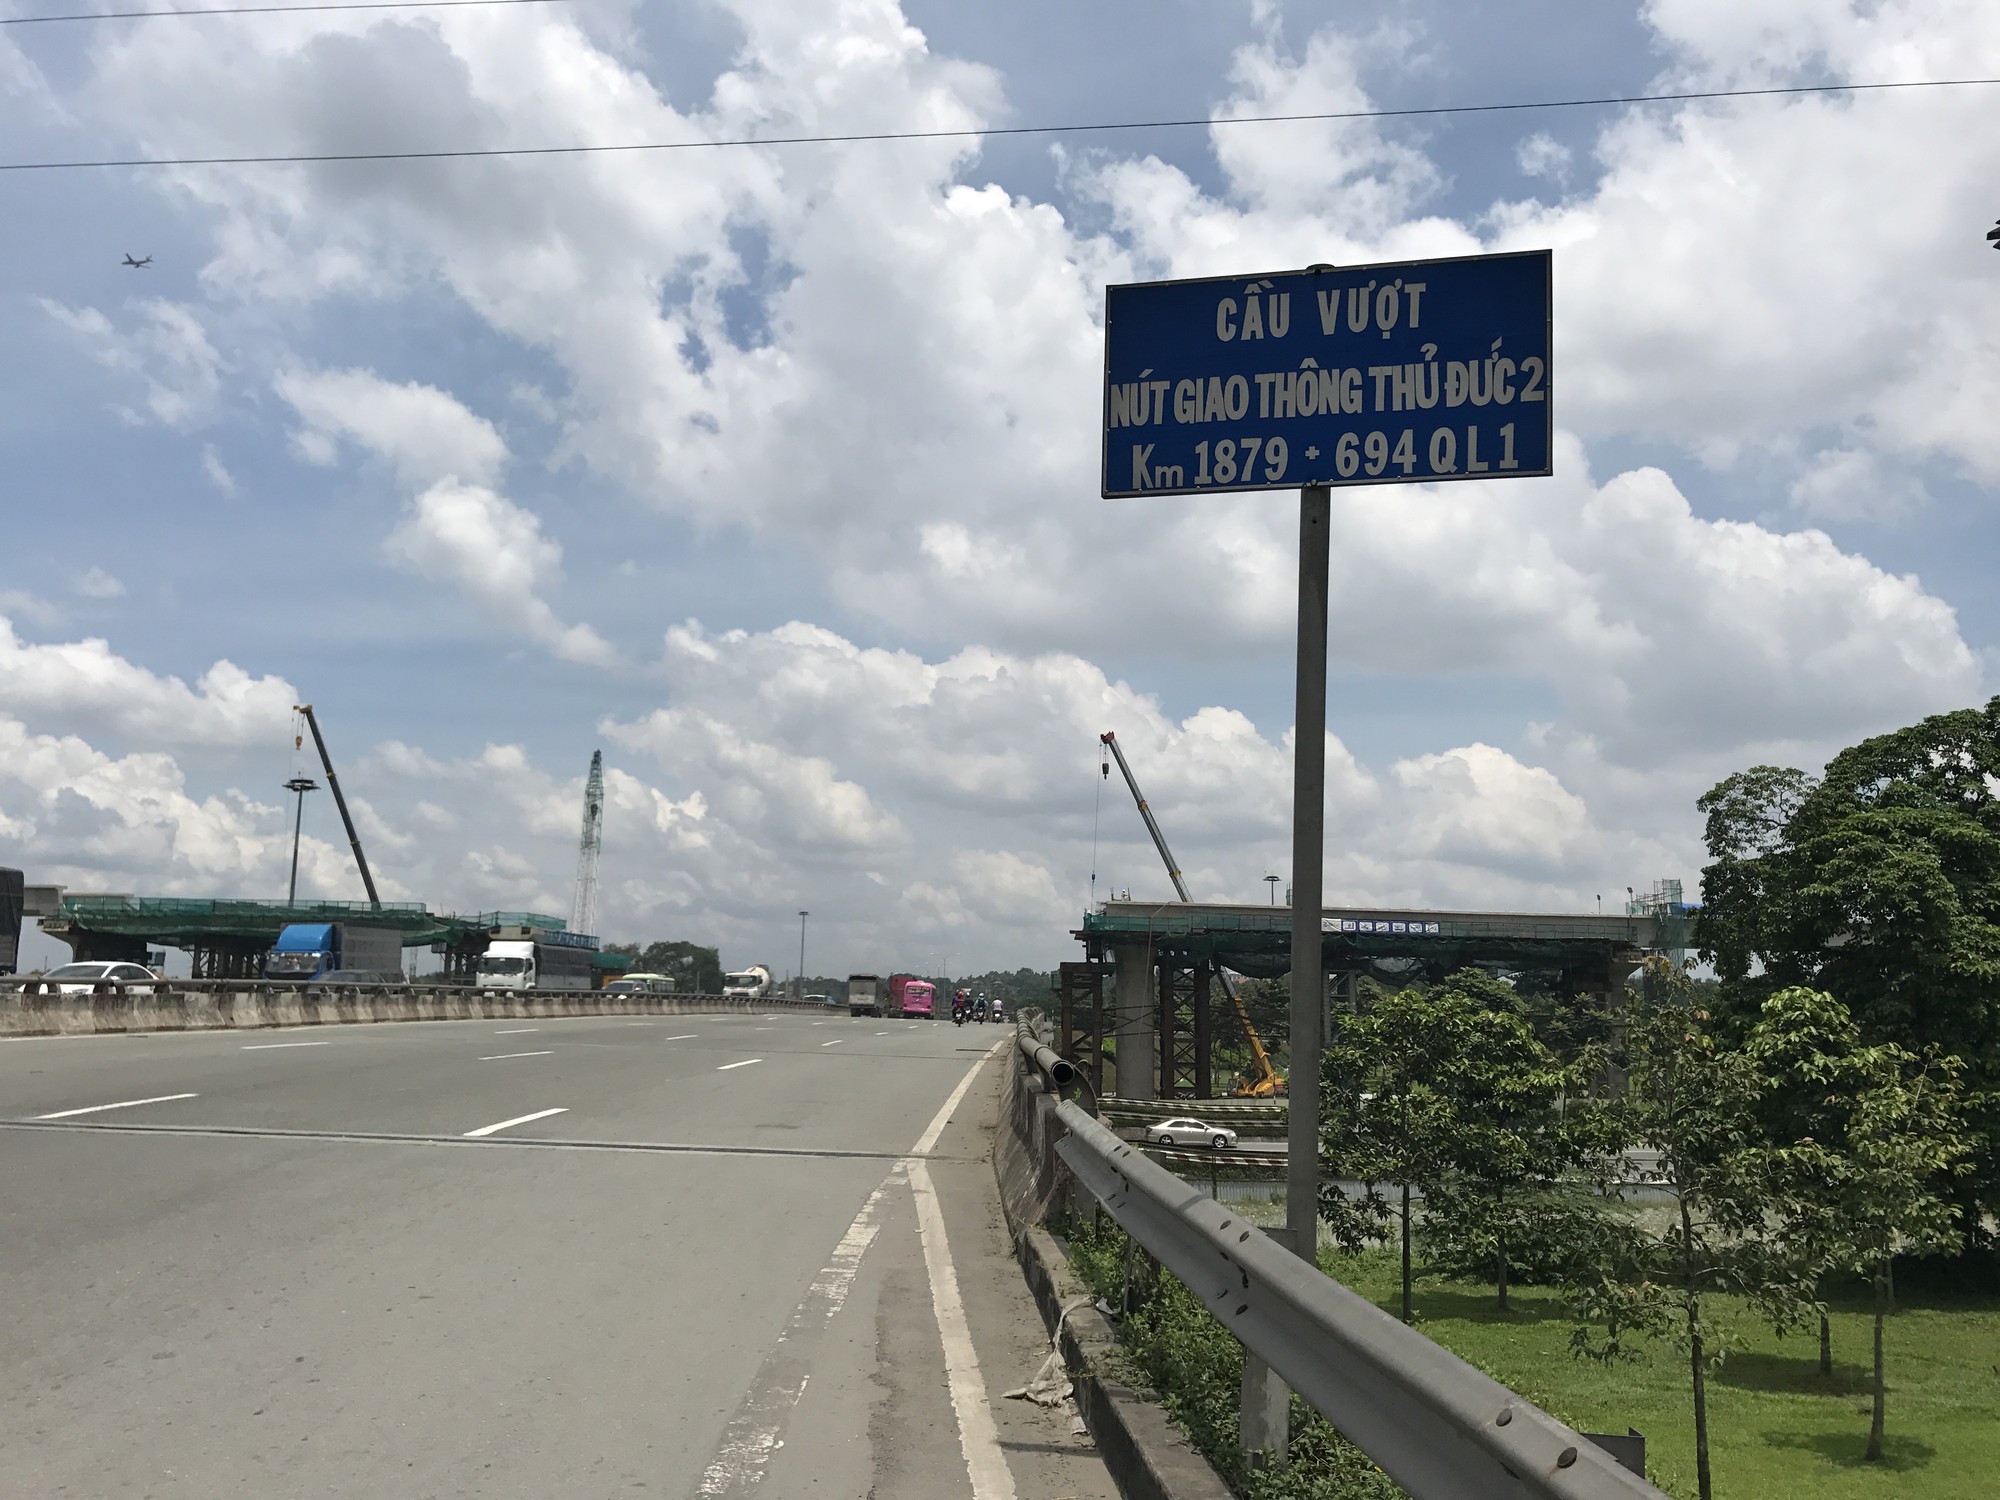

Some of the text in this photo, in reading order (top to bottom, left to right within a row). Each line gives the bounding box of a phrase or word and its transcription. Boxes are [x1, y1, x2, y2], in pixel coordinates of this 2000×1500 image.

[1216, 278, 1426, 342] CẦU VƯỢT
[1110, 336, 1545, 428] NÚT GIAO THÔNG THỦ ĐỨC 2
[1132, 444, 1184, 490] Km
[1194, 436, 1288, 484] 1879
[1335, 428, 1417, 478] 694
